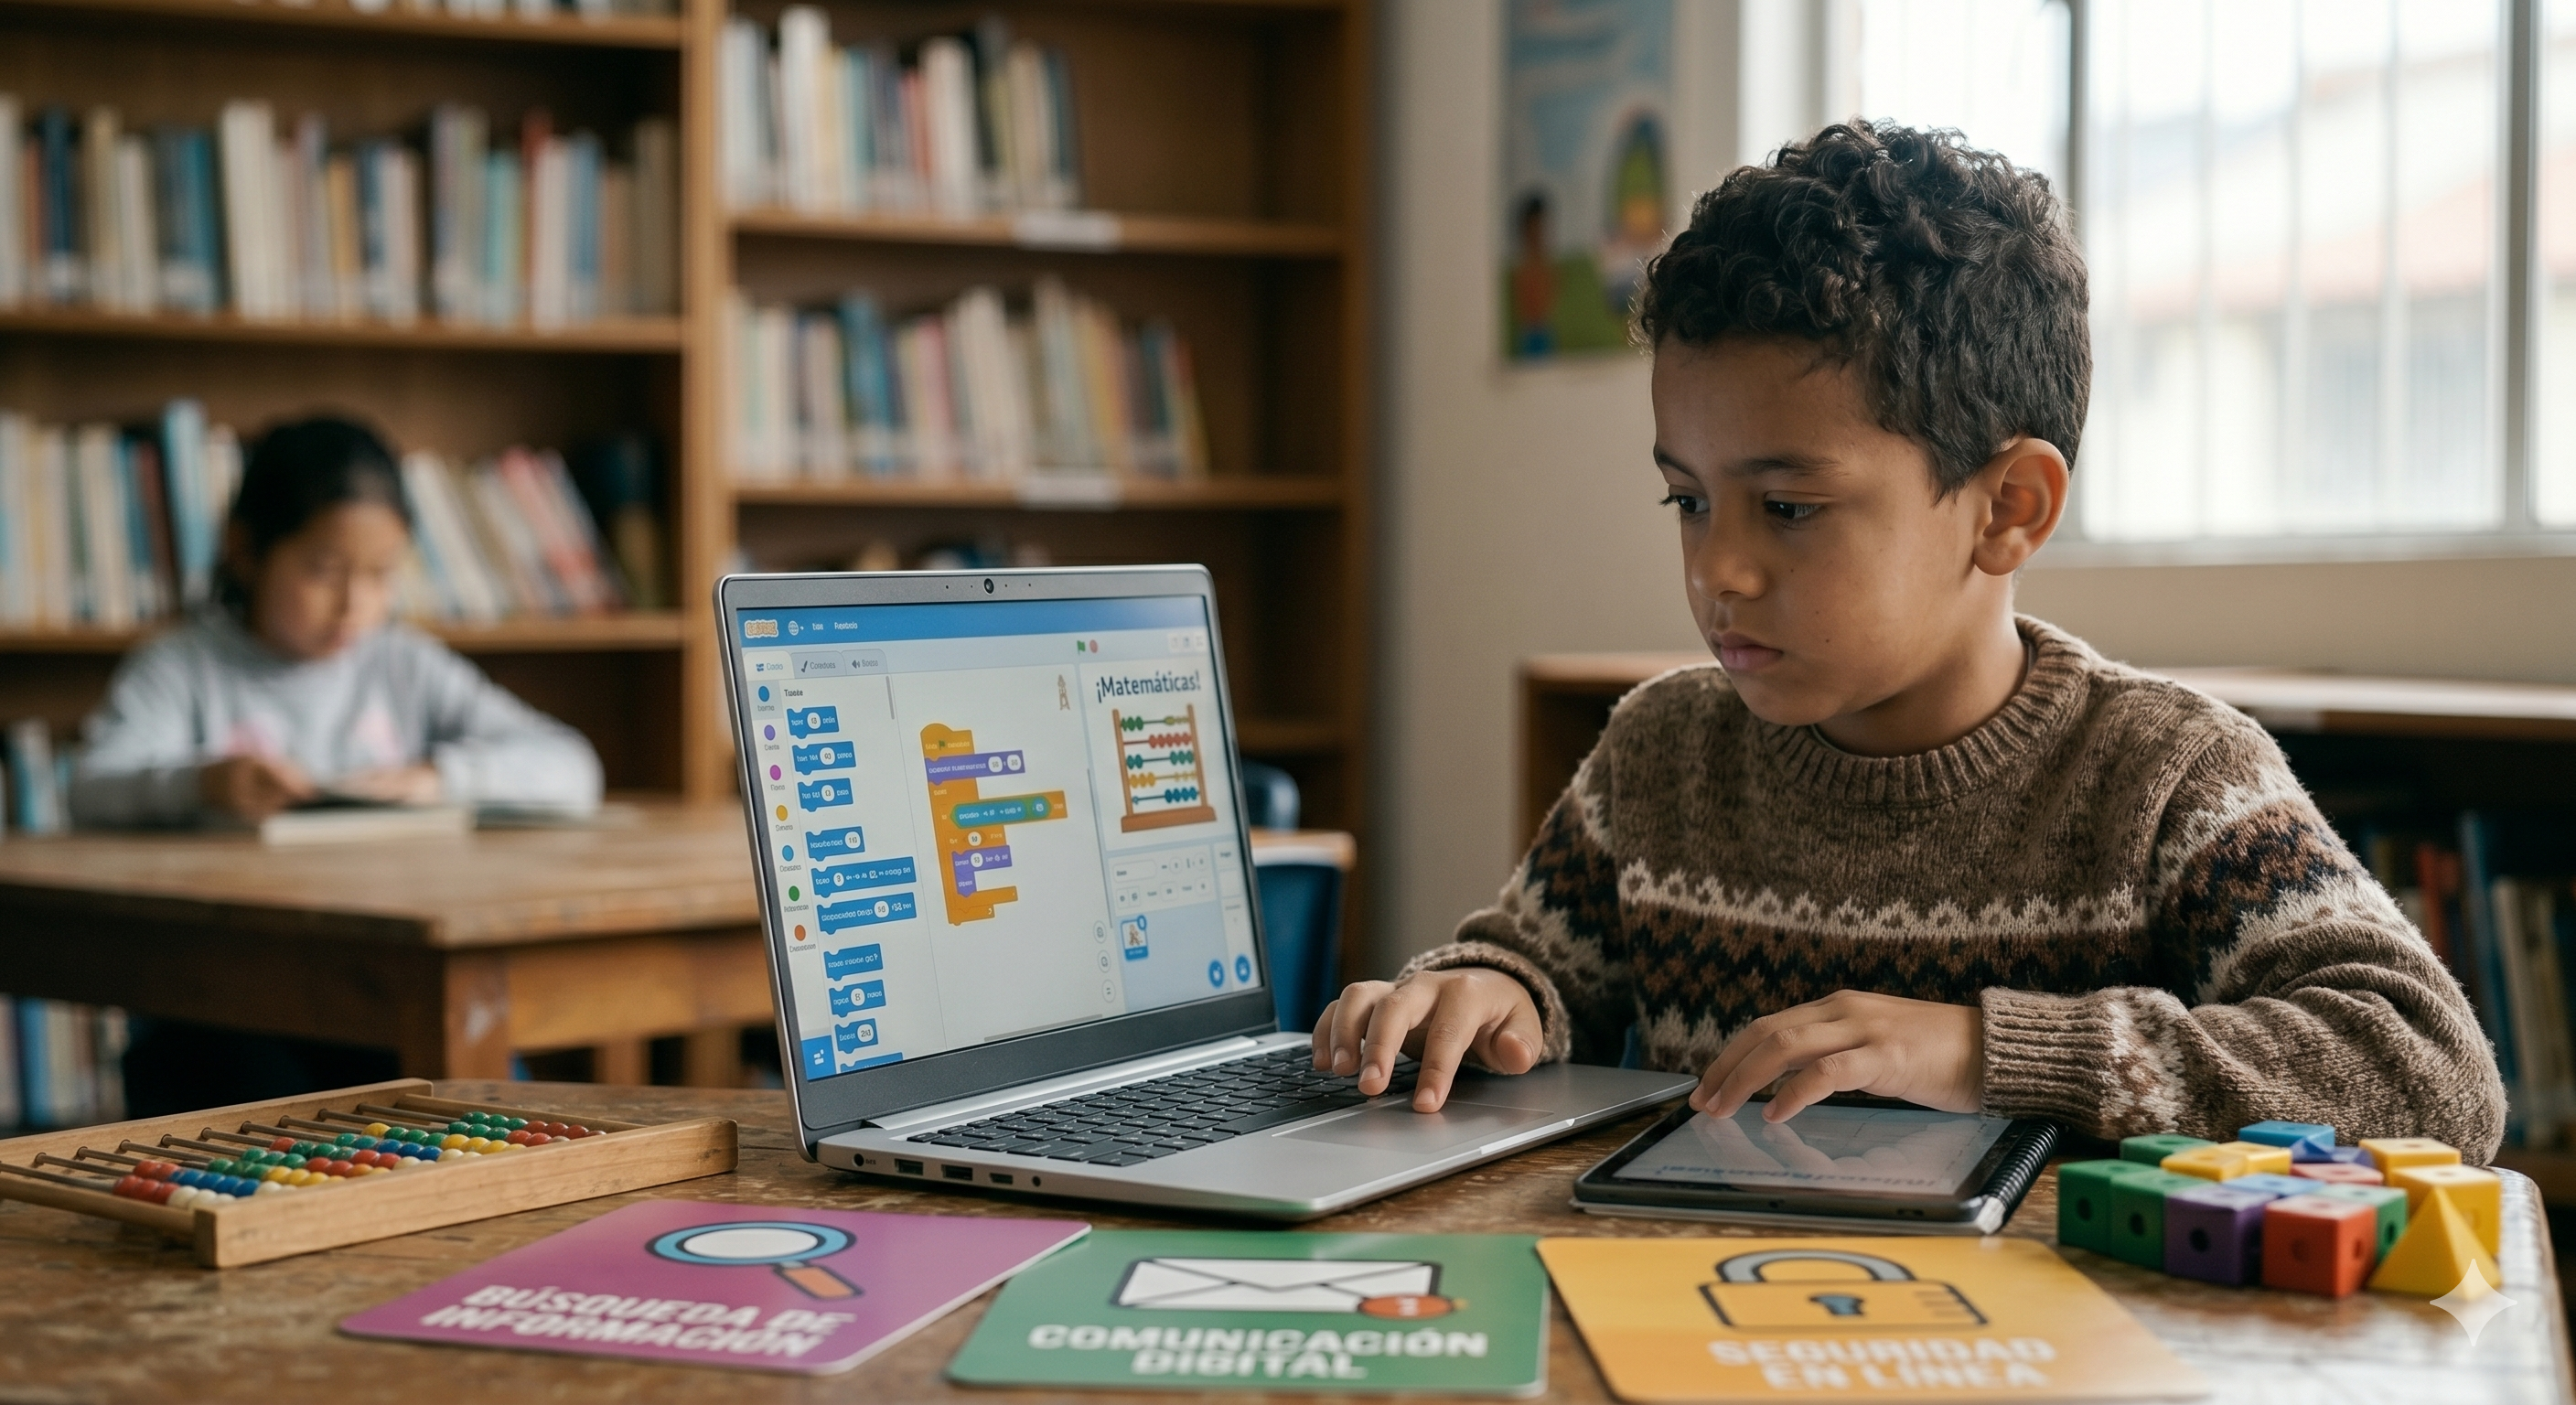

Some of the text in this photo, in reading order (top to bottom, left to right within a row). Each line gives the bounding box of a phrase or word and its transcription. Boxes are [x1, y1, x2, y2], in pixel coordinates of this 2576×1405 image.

[1096, 669, 1201, 703] ¡Matemáticas!
[462, 1284, 857, 1335] BÚSQUEDA DE
[420, 1305, 827, 1357] INFORMACIÓN
[1028, 1324, 1488, 1357] COMUNICACIÓN
[1132, 1348, 1369, 1379] DIGITAL
[1708, 1337, 2057, 1366] SEGURIDAD
[1762, 1362, 1851, 1389] EN
